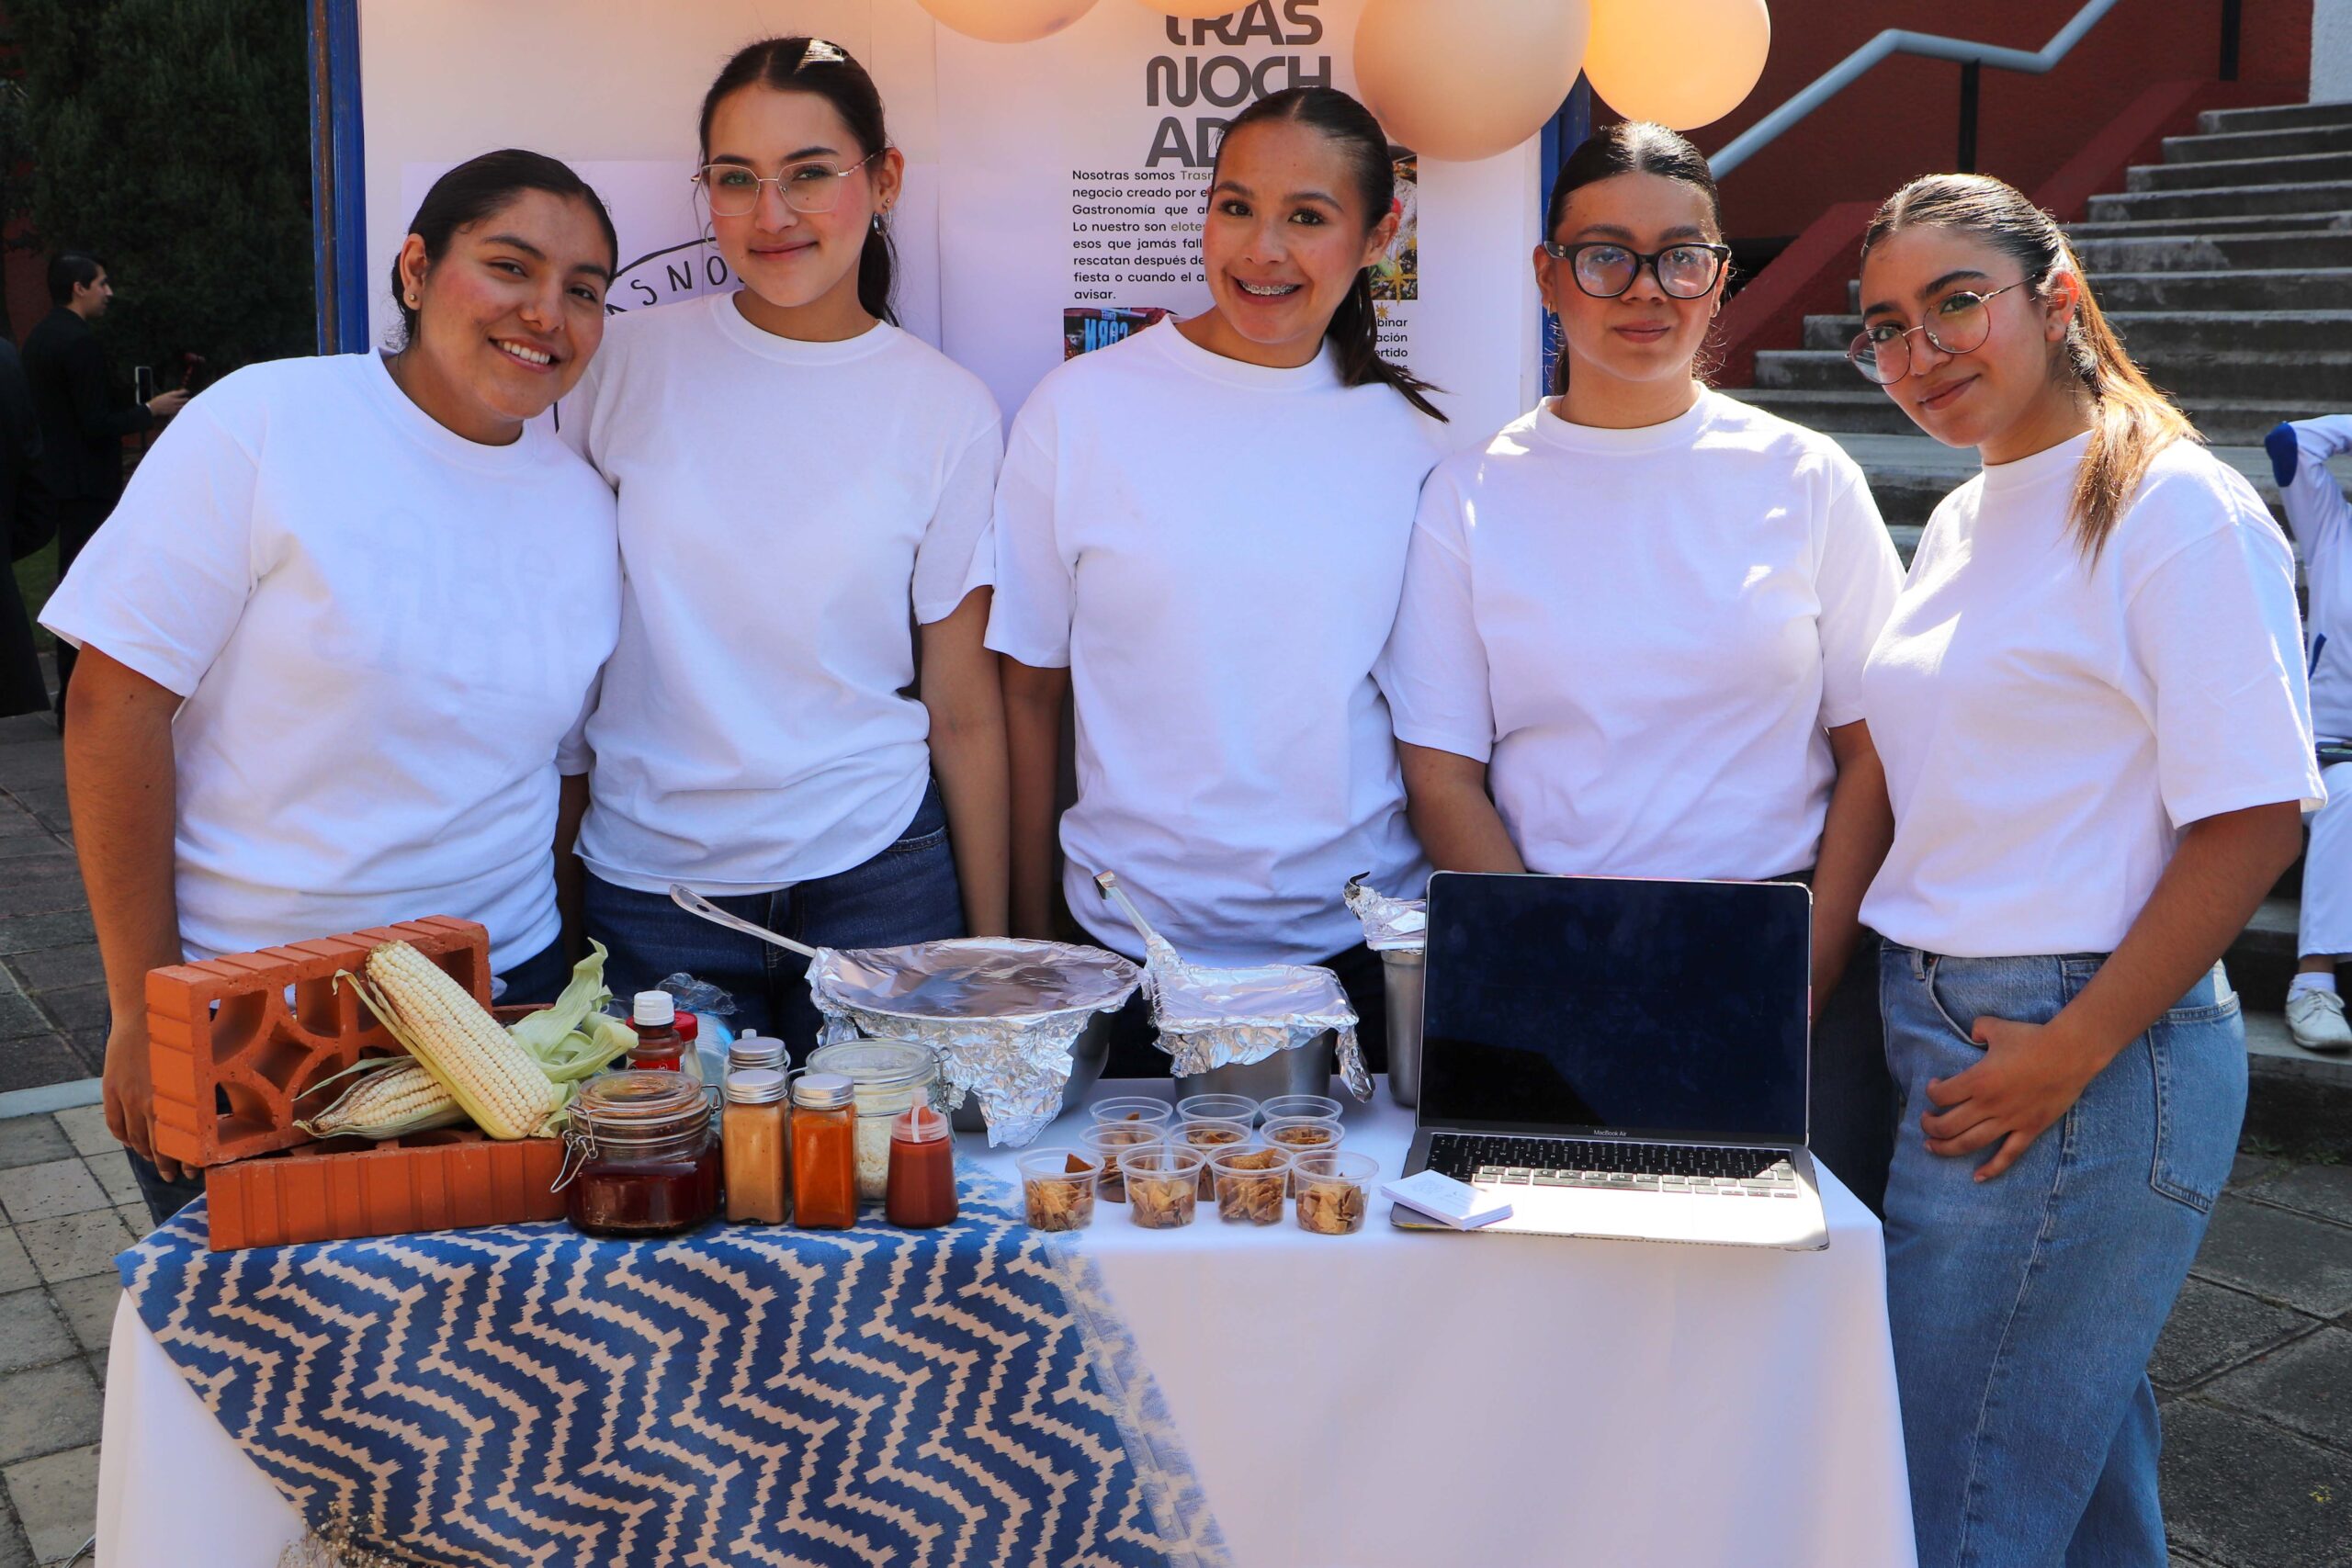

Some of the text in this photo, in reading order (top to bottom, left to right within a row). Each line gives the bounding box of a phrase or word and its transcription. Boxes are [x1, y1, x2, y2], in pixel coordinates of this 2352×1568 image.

[1146, 55, 1331, 107] NOCH
[1072, 170, 1129, 181] Nosotras
[1134, 172, 1175, 181] somos
[1072, 186, 1123, 199] negocio
[1126, 186, 1171, 197] creado
[1175, 189, 1196, 199] por
[1072, 204, 1156, 215] Gastronomía
[1164, 207, 1189, 217] que
[1072, 221, 1088, 231] Lo
[1091, 222, 1140, 231] nuestro
[1144, 223, 1167, 231] son
[1072, 240, 1102, 249] esos
[1107, 240, 1132, 250] que
[1136, 238, 1177, 251] jamás
[1073, 255, 1130, 265] rescatan
[1134, 254, 1186, 267] después
[1073, 272, 1110, 282] fiesta
[1114, 274, 1123, 282] o
[1127, 272, 1176, 282] cuando
[1181, 272, 1192, 282] el
[605, 255, 745, 315] SNO
[1074, 288, 1116, 299] avisar.
